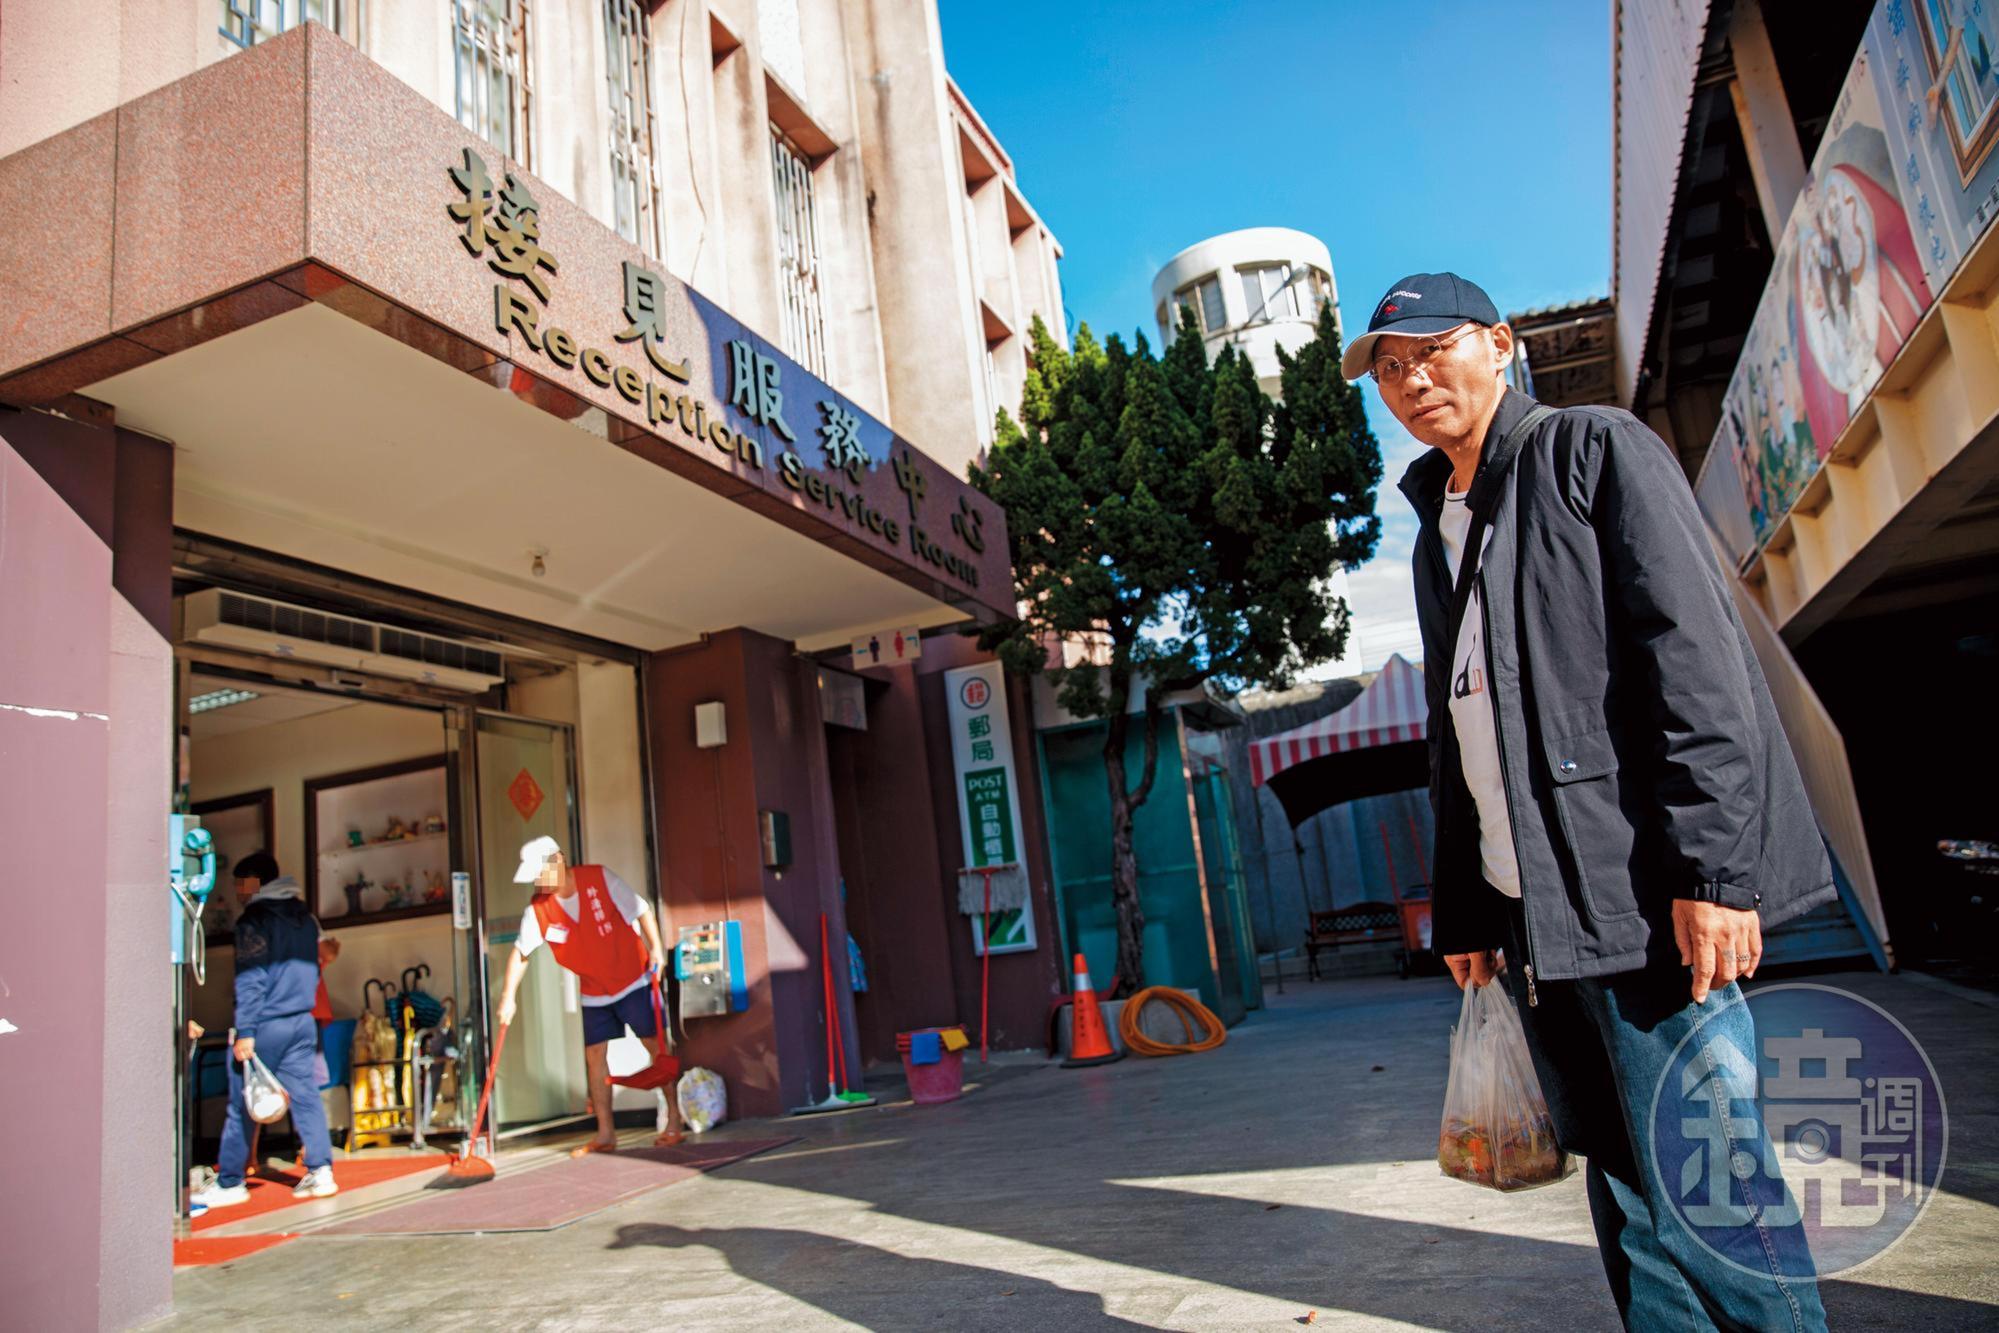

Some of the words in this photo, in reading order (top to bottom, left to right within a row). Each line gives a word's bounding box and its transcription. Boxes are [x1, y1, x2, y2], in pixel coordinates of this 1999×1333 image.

[447, 146, 984, 554] 接見服務中心
[494, 285, 763, 470] Reception
[777, 451, 899, 544] Service
[909, 524, 979, 588] Room
[968, 714, 994, 763] 郵局
[968, 774, 1003, 791] POST
[976, 790, 1000, 801] ATM
